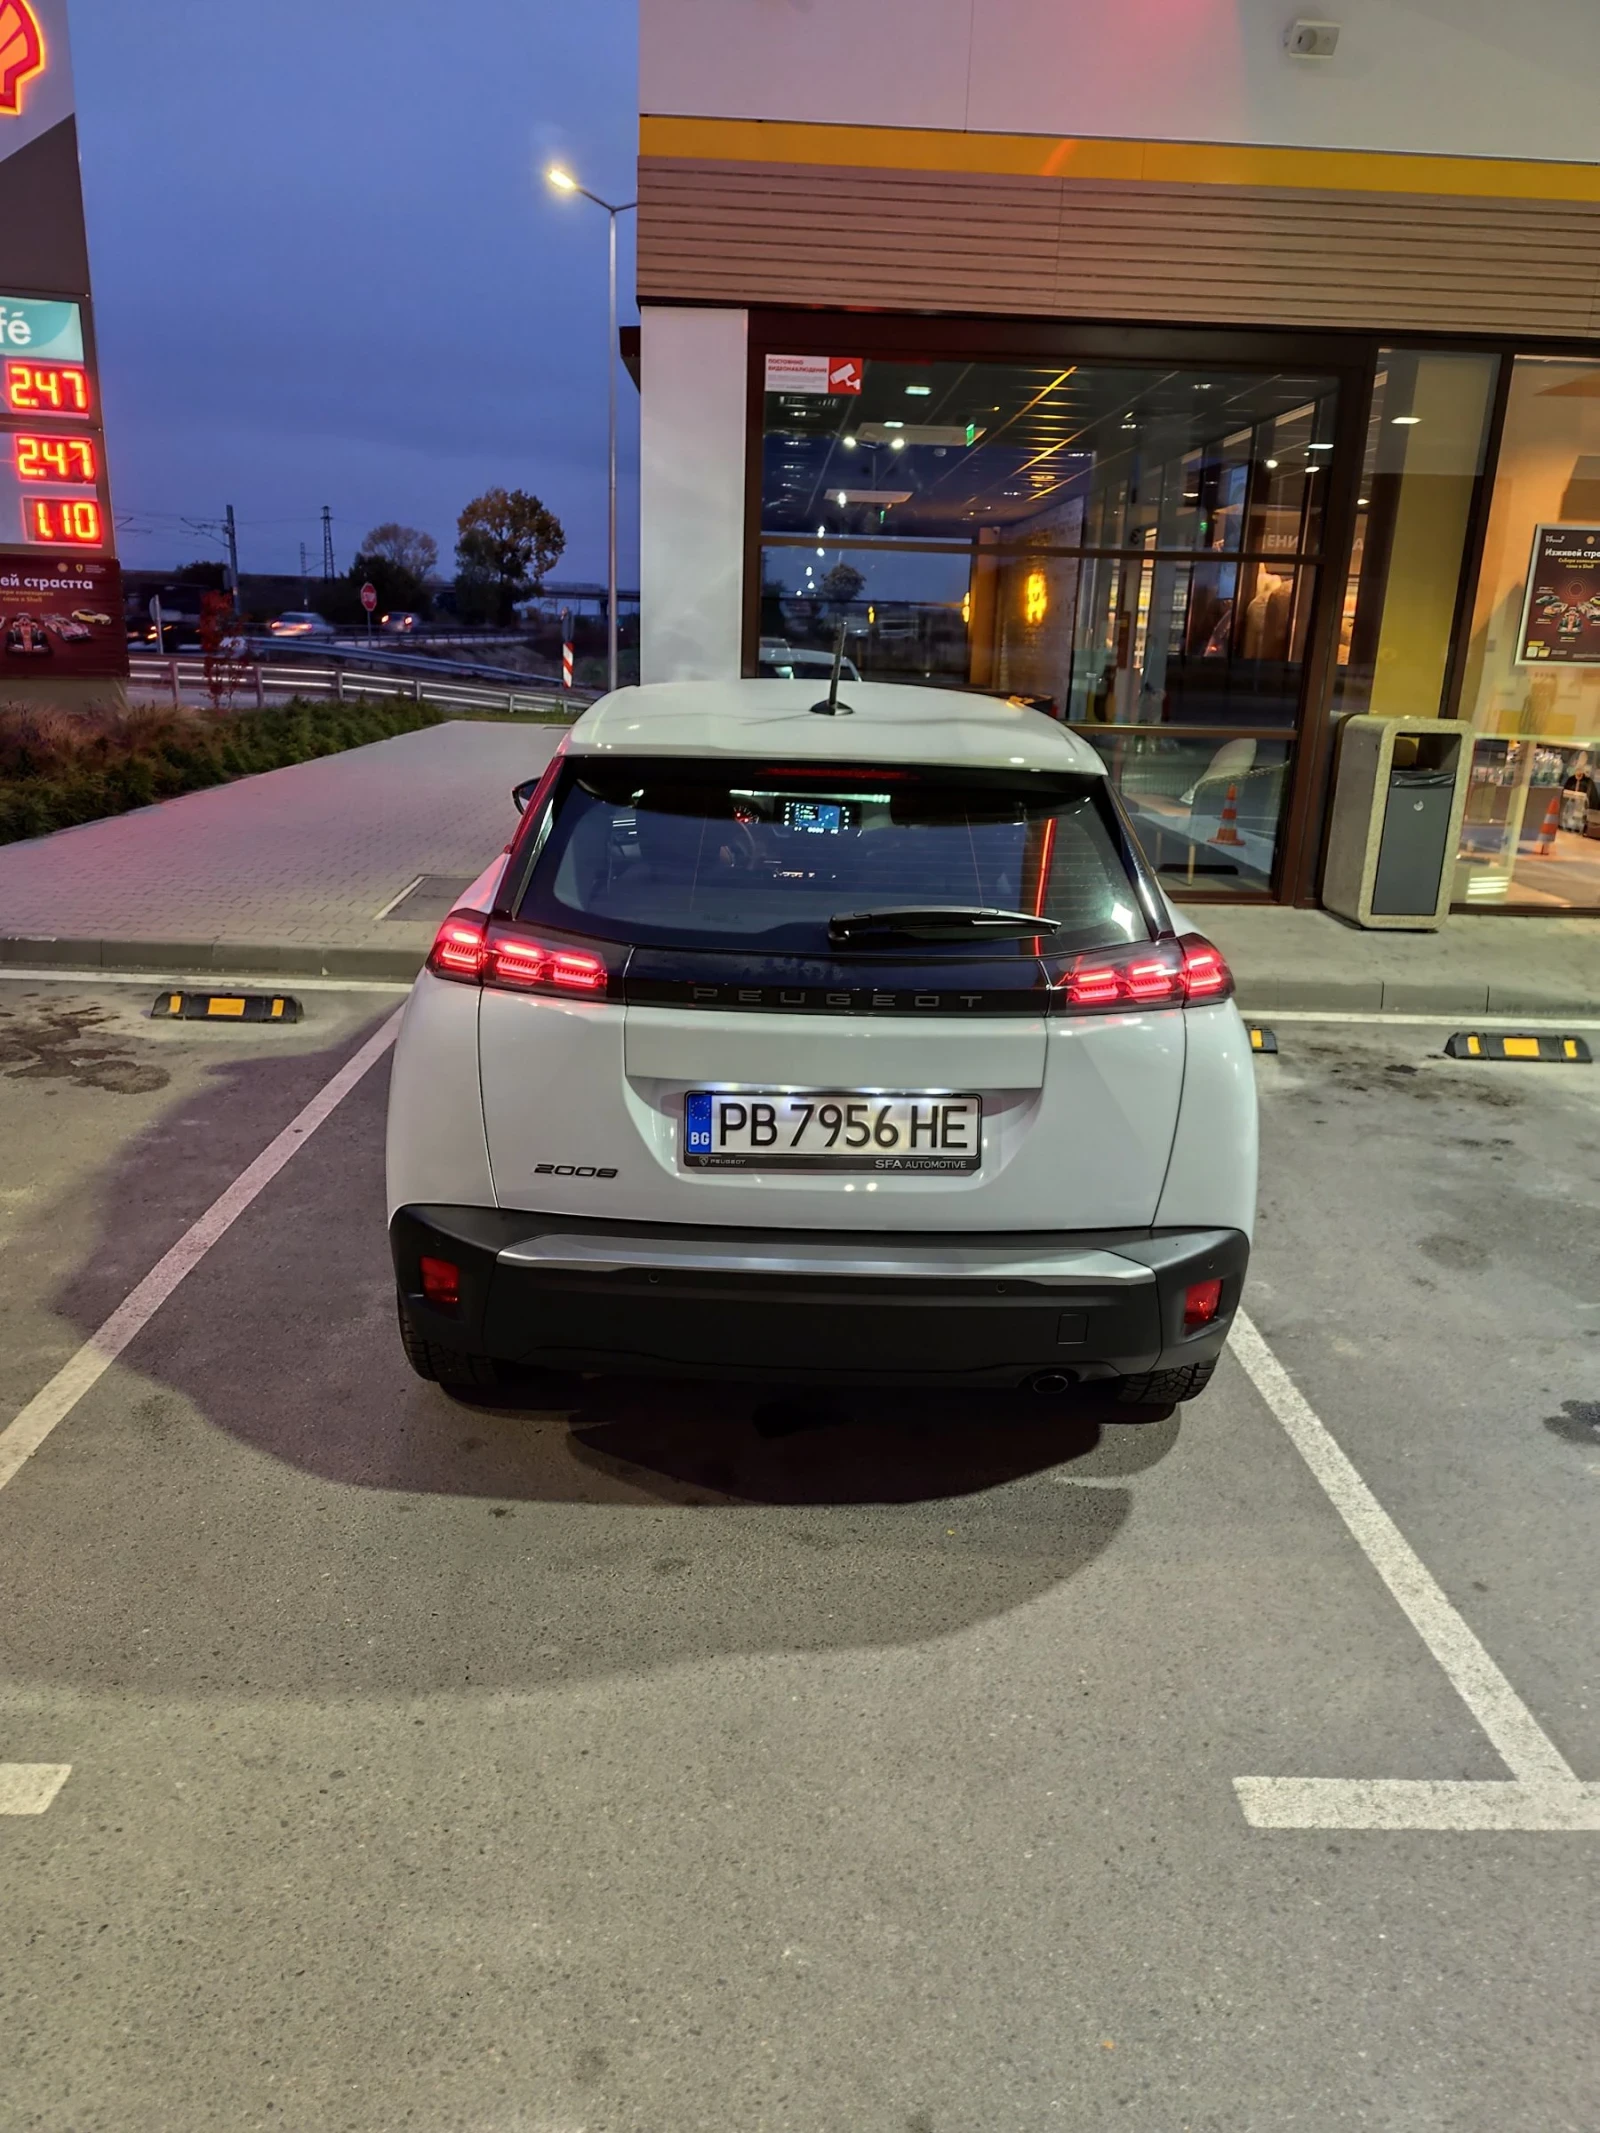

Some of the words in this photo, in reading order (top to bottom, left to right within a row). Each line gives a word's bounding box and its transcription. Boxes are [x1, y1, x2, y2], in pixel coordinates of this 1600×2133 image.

[10, 367, 86, 408] 2.47
[18, 439, 94, 478] 2.47
[0, 574, 20, 587] ей
[24, 577, 93, 591] страстта
[693, 988, 983, 1008] PEUGEOT
[691, 1132, 710, 1145] BG
[720, 1103, 778, 1146] PB
[790, 1104, 899, 1148] 7956
[910, 1105, 968, 1149] HE
[534, 1164, 618, 1179] 2008
[874, 1159, 903, 1170] SFA
[905, 1161, 967, 1170] AUTOMOTIVE
